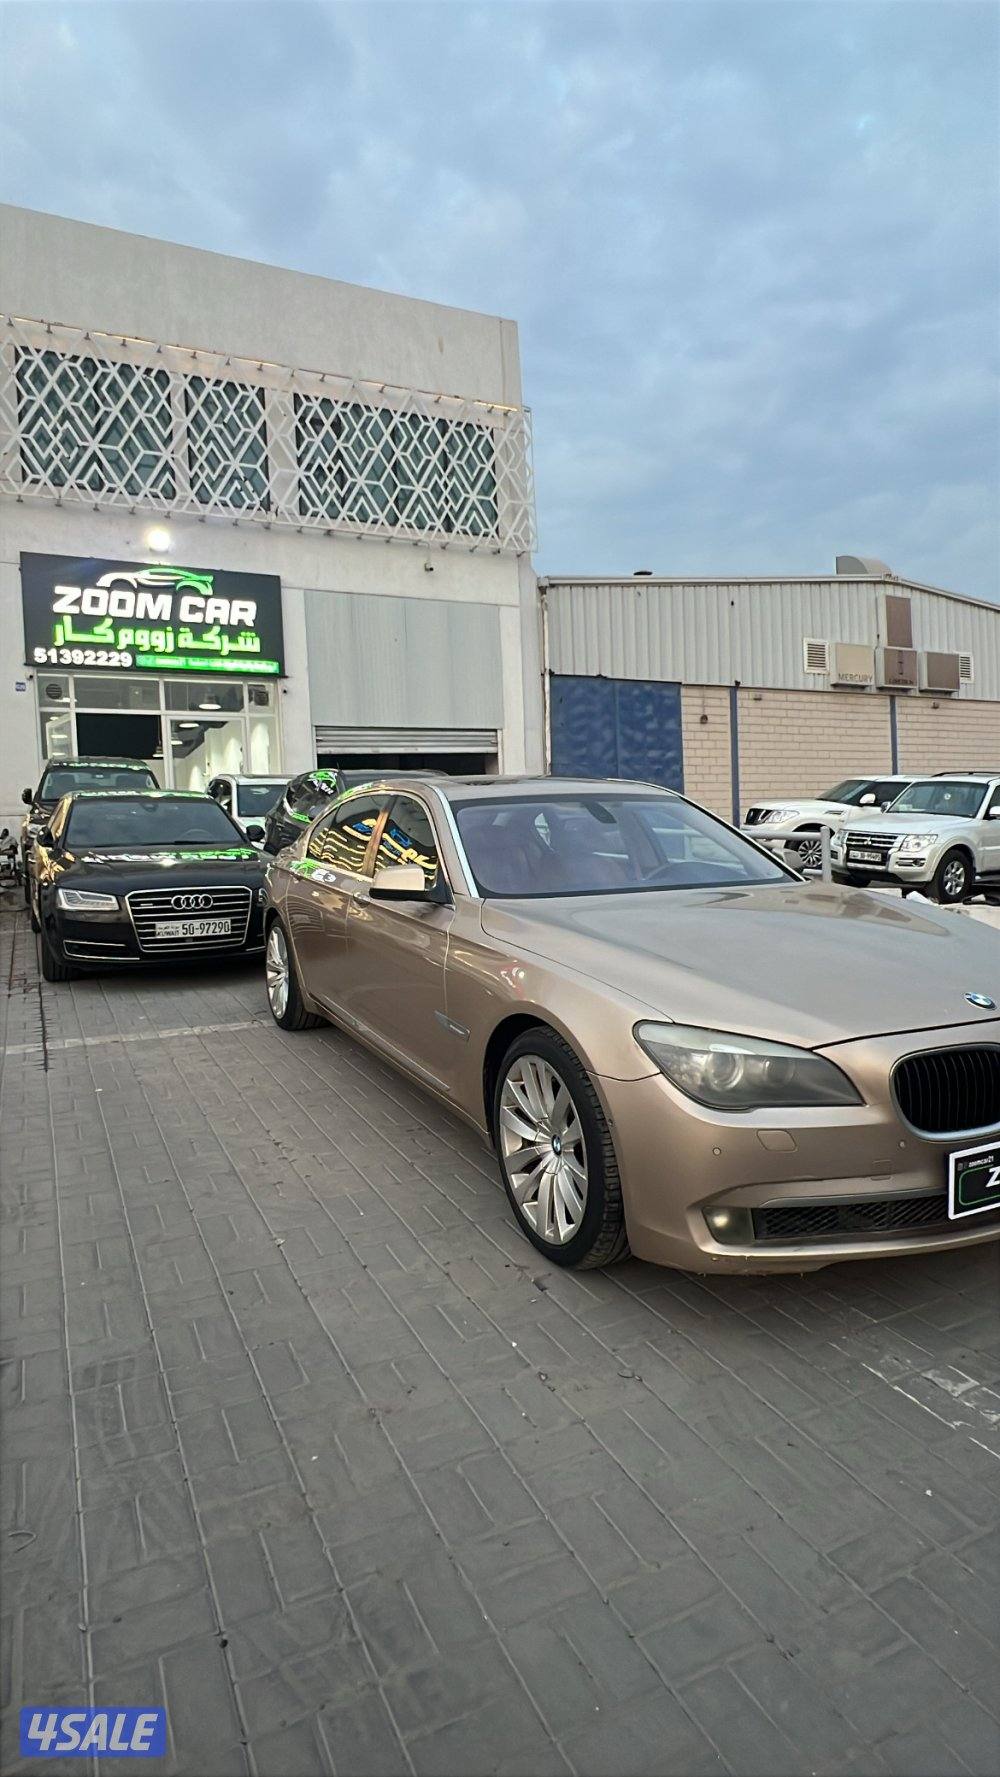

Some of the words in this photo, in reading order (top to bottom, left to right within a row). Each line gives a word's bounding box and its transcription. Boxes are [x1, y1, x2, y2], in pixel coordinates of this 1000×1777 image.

[53, 585, 173, 621] ZOOM
[179, 595, 257, 627] CAR
[54, 615, 115, 646] كار
[117, 626, 174, 653] زووم
[178, 625, 261, 656] شركة
[838, 673, 873, 683] MERCURY
[181, 921, 230, 936] 50-97290
